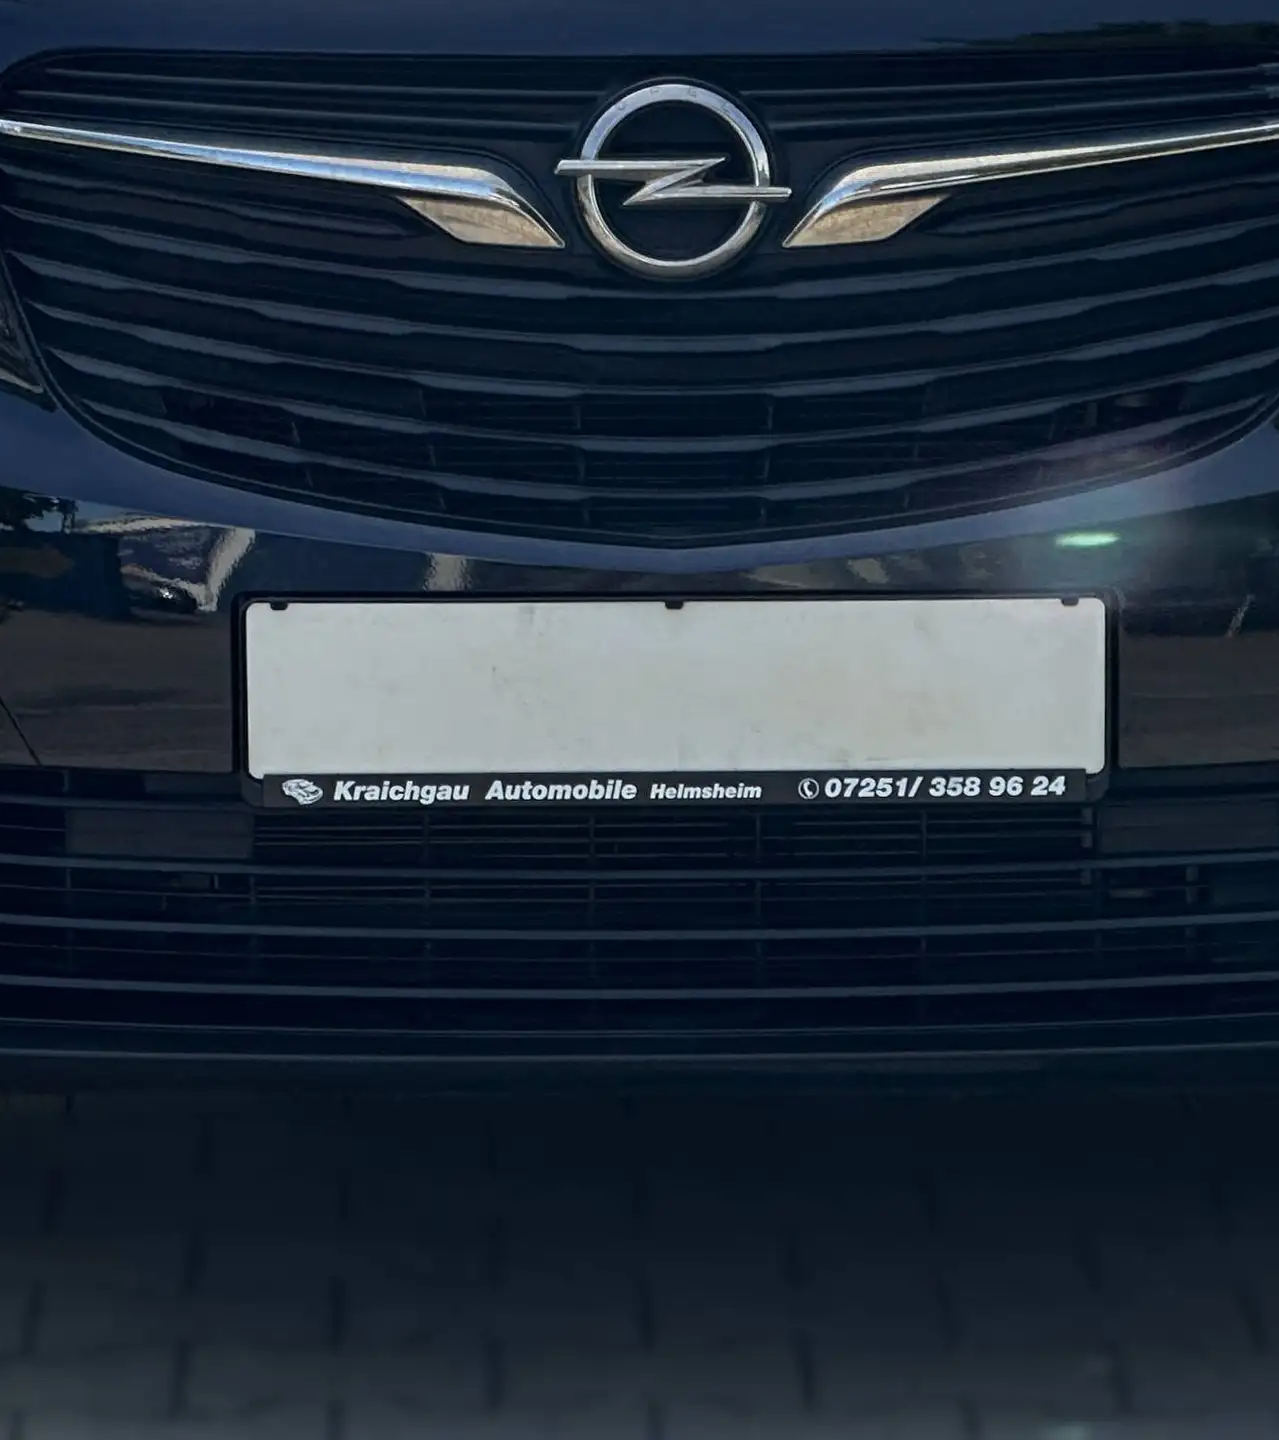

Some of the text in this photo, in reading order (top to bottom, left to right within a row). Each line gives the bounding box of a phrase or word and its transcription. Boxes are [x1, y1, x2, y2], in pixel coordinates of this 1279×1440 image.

[333, 775, 1066, 805] Kraichgau Automobile Helmsheim 07251/ 358 96 24
